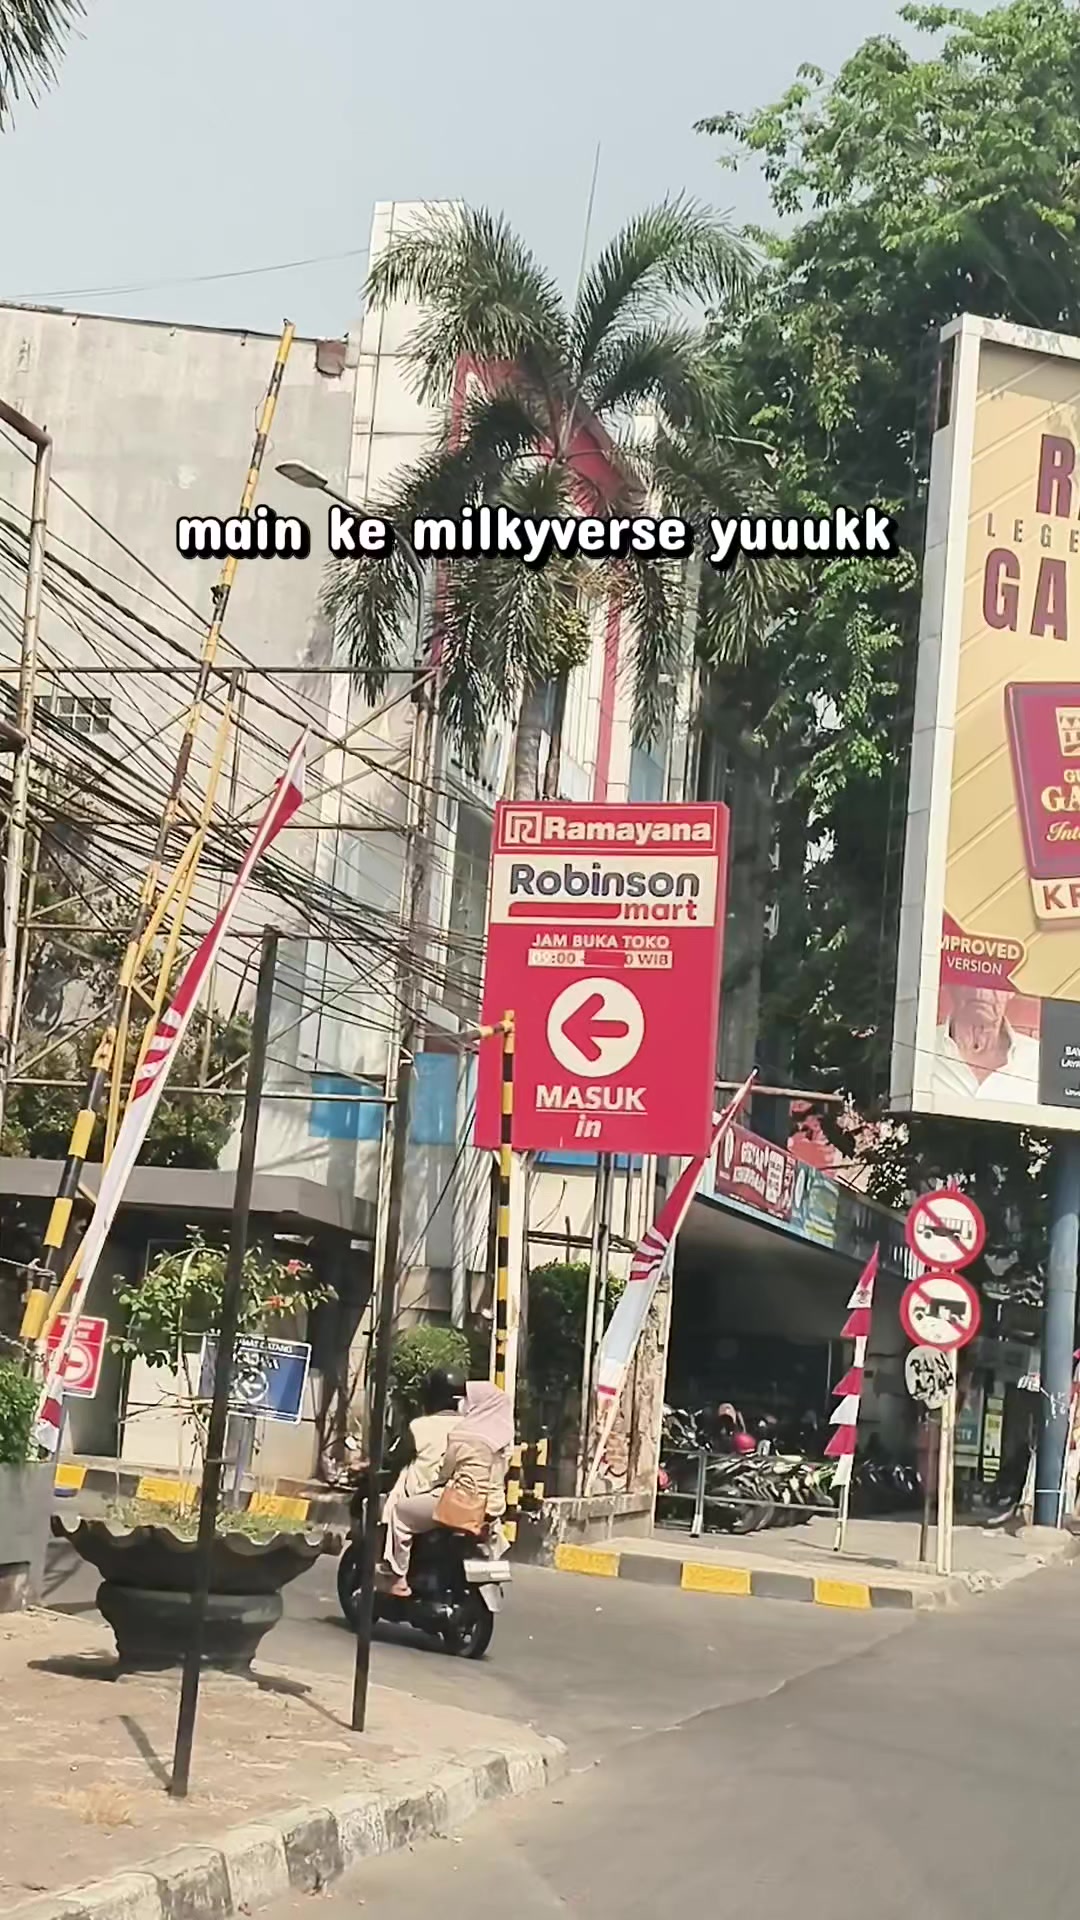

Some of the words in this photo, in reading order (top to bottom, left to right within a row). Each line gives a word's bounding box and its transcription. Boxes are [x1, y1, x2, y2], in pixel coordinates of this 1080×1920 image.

[1036, 433, 1080, 519] R
[986, 512, 1080, 554] LEGE
[982, 547, 1069, 642] GA
[543, 815, 712, 846] Ramayana
[509, 861, 700, 898] Robinson
[623, 899, 698, 921] mart
[531, 933, 568, 948] JAM
[572, 934, 619, 949] BUKA
[622, 935, 670, 949] TOKO
[638, 953, 669, 967] WIB
[946, 955, 1003, 976] VERSION
[535, 1084, 648, 1112] MASUK
[574, 1113, 602, 1139] in
